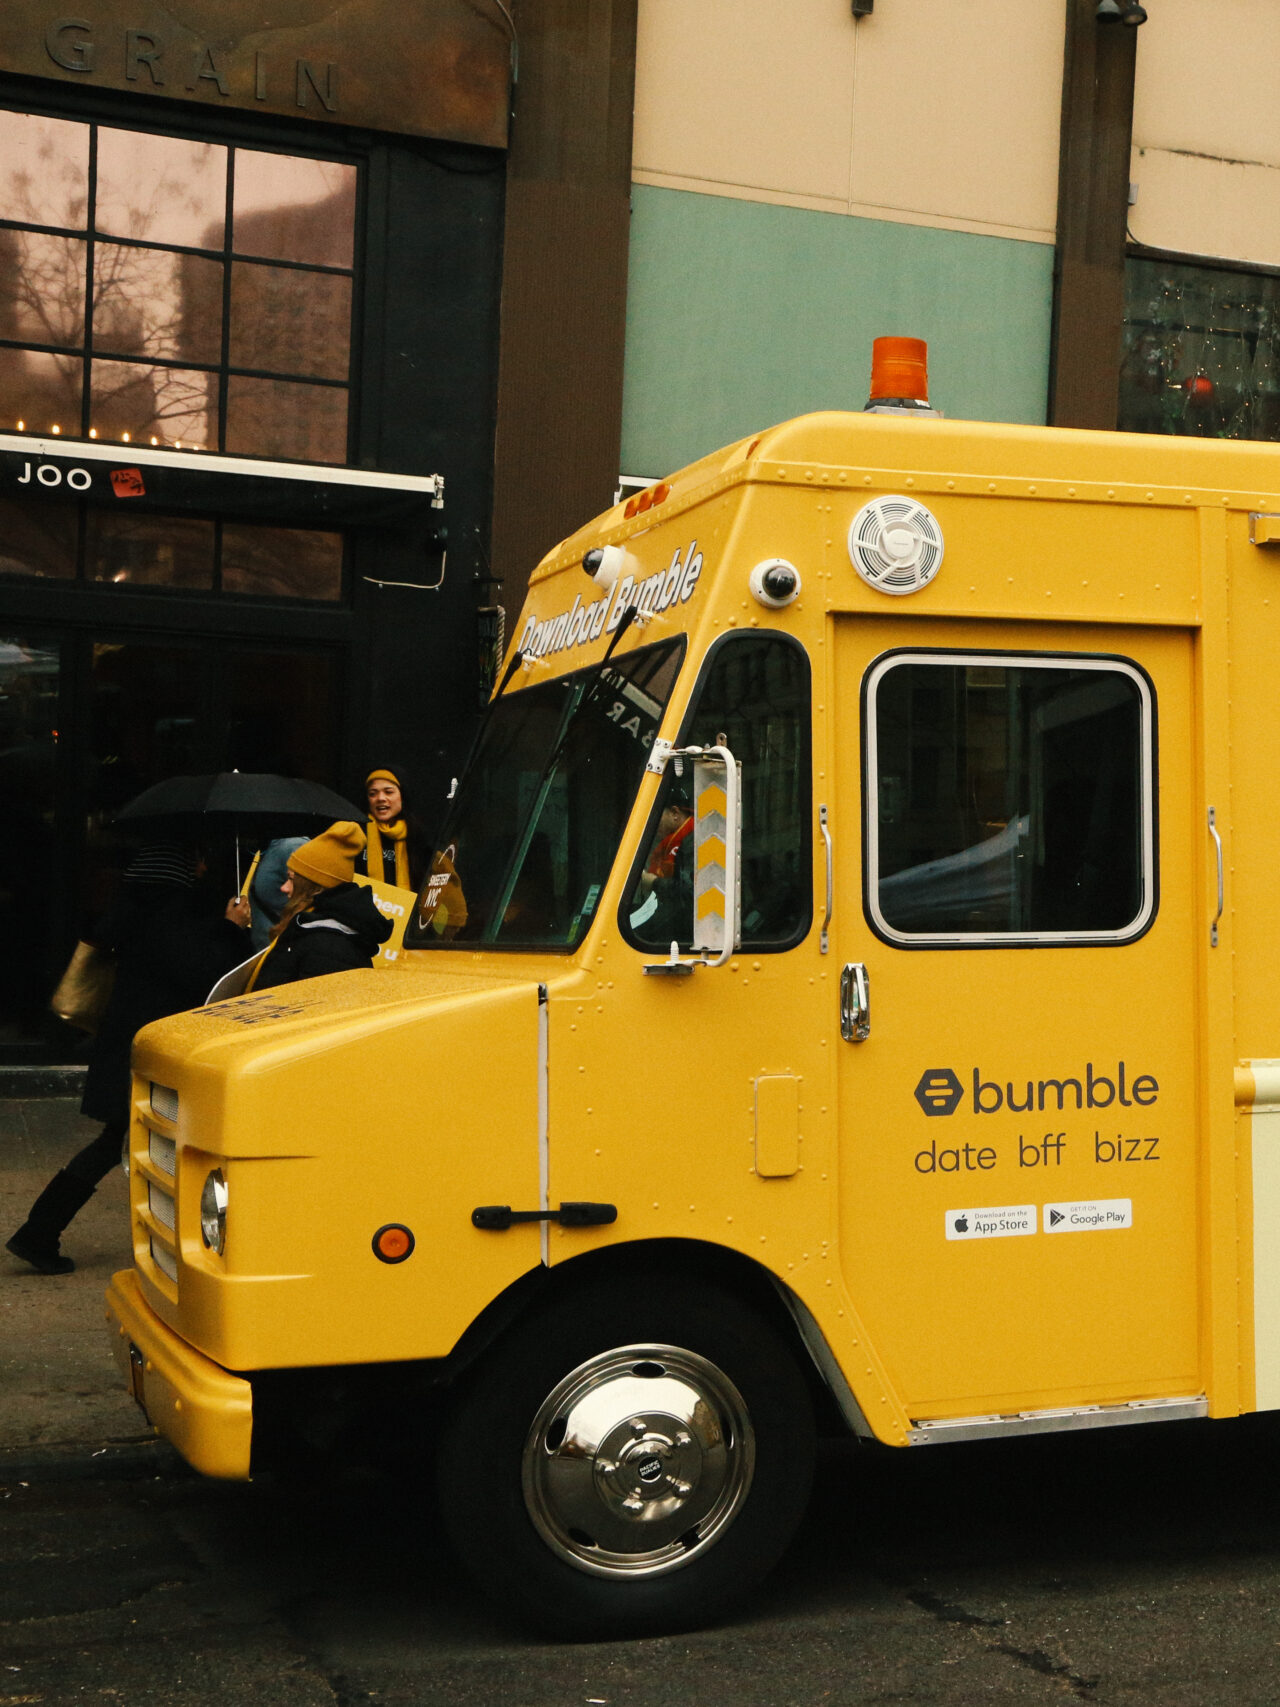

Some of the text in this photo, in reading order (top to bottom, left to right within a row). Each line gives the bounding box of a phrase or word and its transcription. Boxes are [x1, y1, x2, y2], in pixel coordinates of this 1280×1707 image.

[45, 18, 337, 112] GRAIN
[17, 462, 92, 490] JOO
[518, 540, 703, 657] Download Bumble
[373, 892, 405, 917] hen
[973, 1061, 1159, 1114] bumble
[914, 1131, 1160, 1173] date bff bizz
[974, 1211, 1006, 1219] Download
[974, 1219, 1028, 1235] App Store
[1070, 1212, 1125, 1225] Google Play
